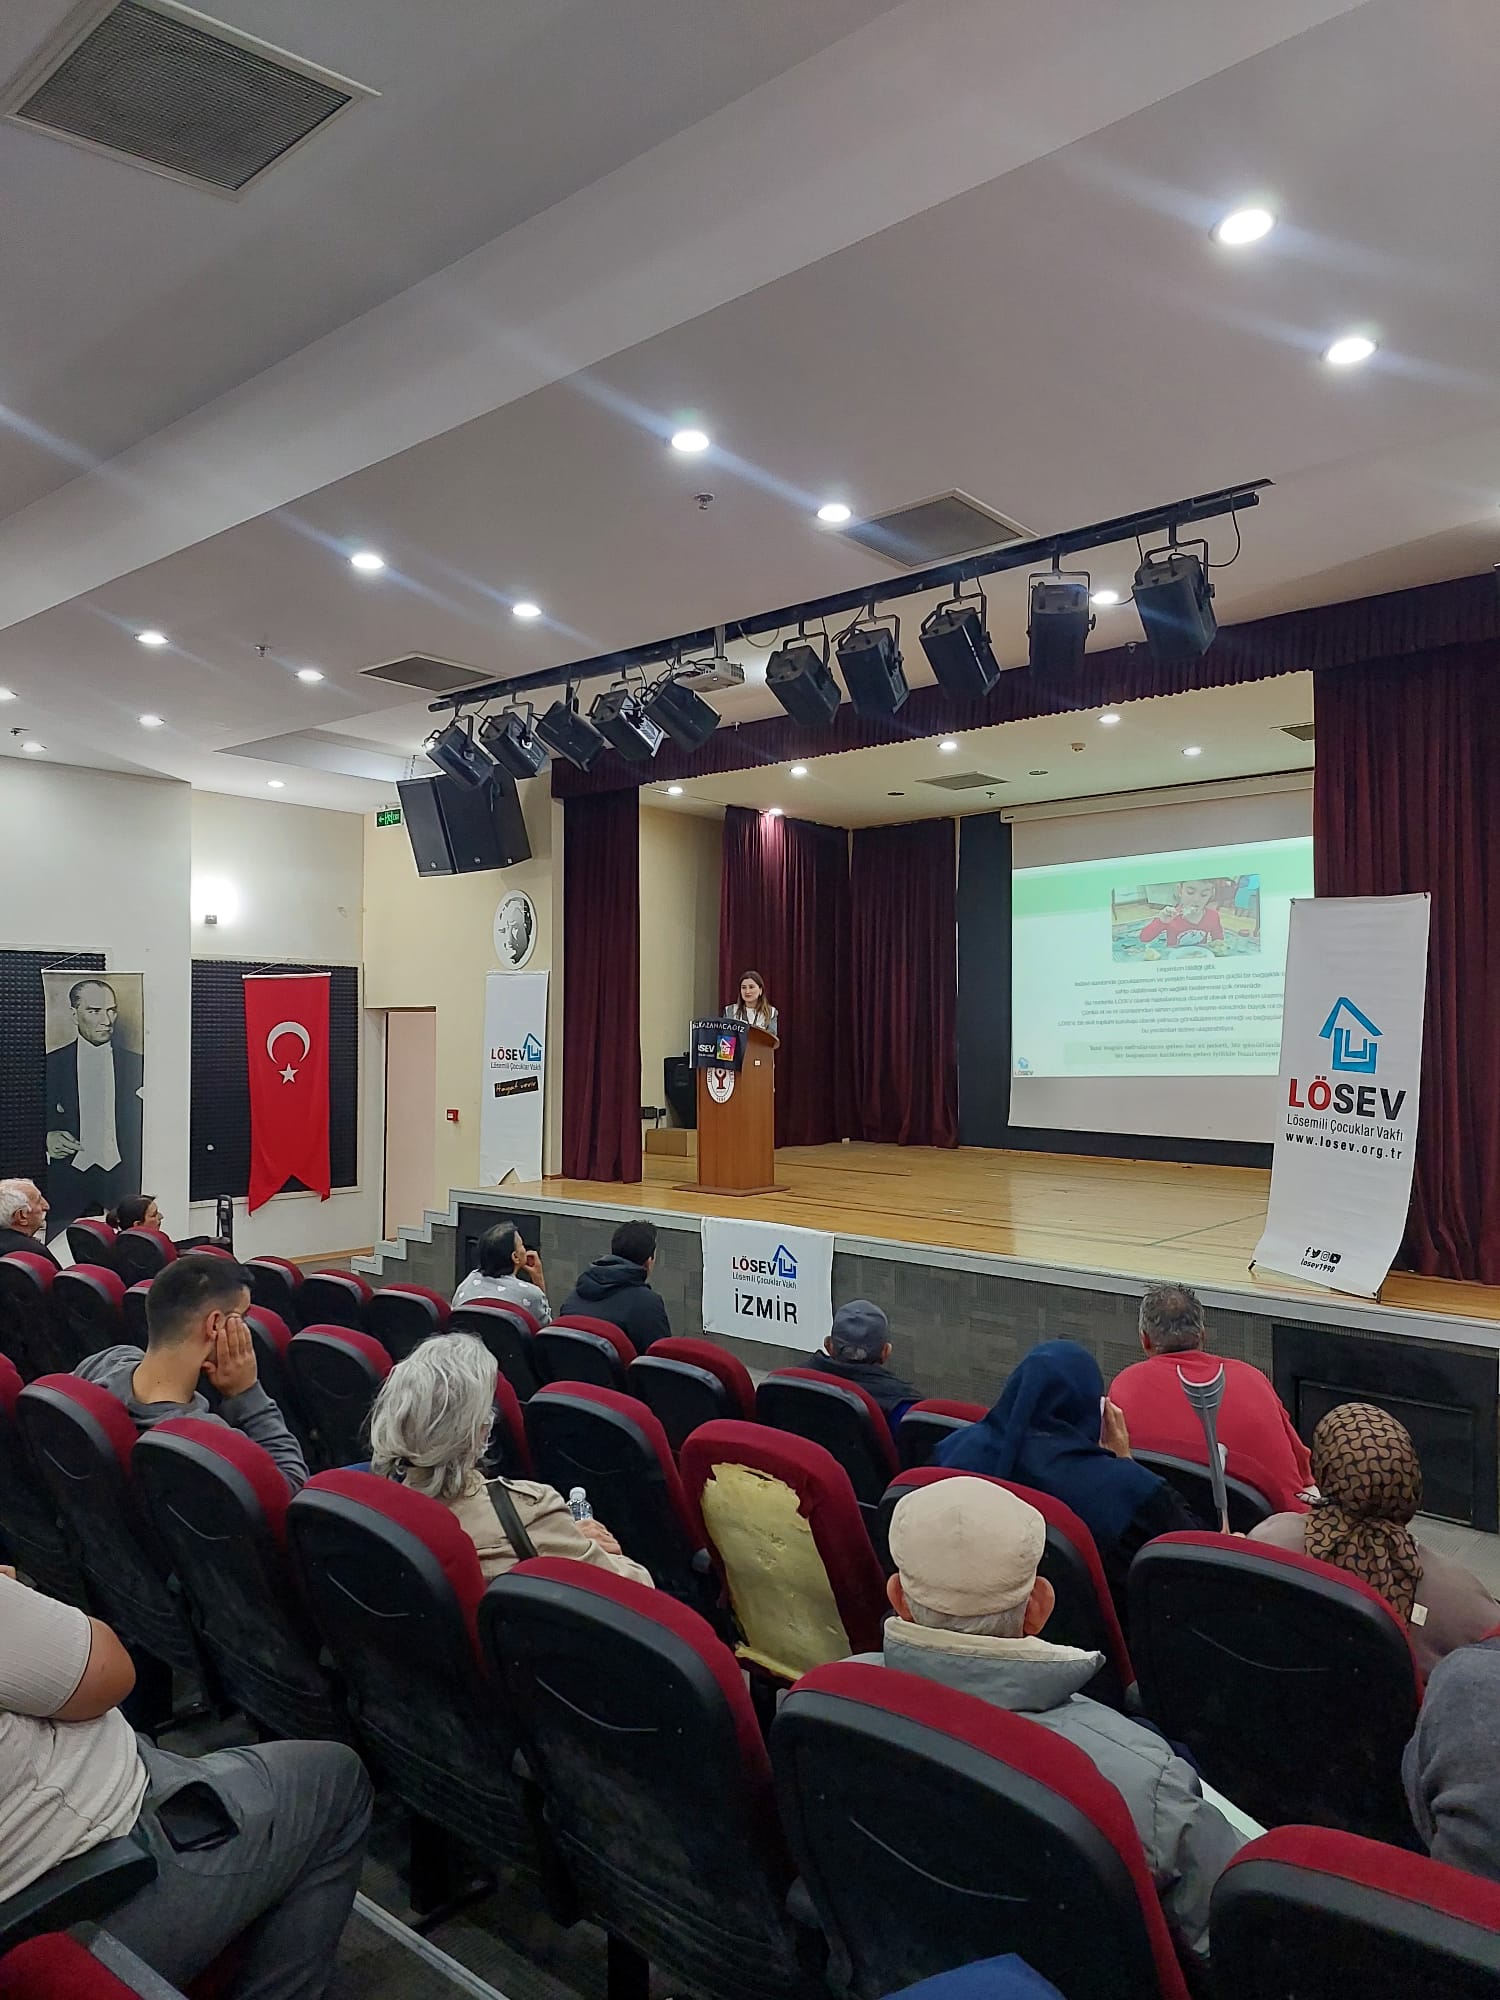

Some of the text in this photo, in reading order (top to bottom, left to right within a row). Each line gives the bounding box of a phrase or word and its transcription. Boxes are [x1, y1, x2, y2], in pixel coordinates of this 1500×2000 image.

[491, 1046, 526, 1060] LÖSEV
[1288, 1075, 1407, 1121] LÖSEV
[1287, 1113, 1404, 1142] Lösemili Çocuklar Vakfı
[1285, 1132, 1403, 1160] www.losev.org.tr
[732, 1255, 777, 1275] LÖSEV
[1300, 1257, 1336, 1273] losev1998
[734, 1287, 798, 1325] İZMİR
